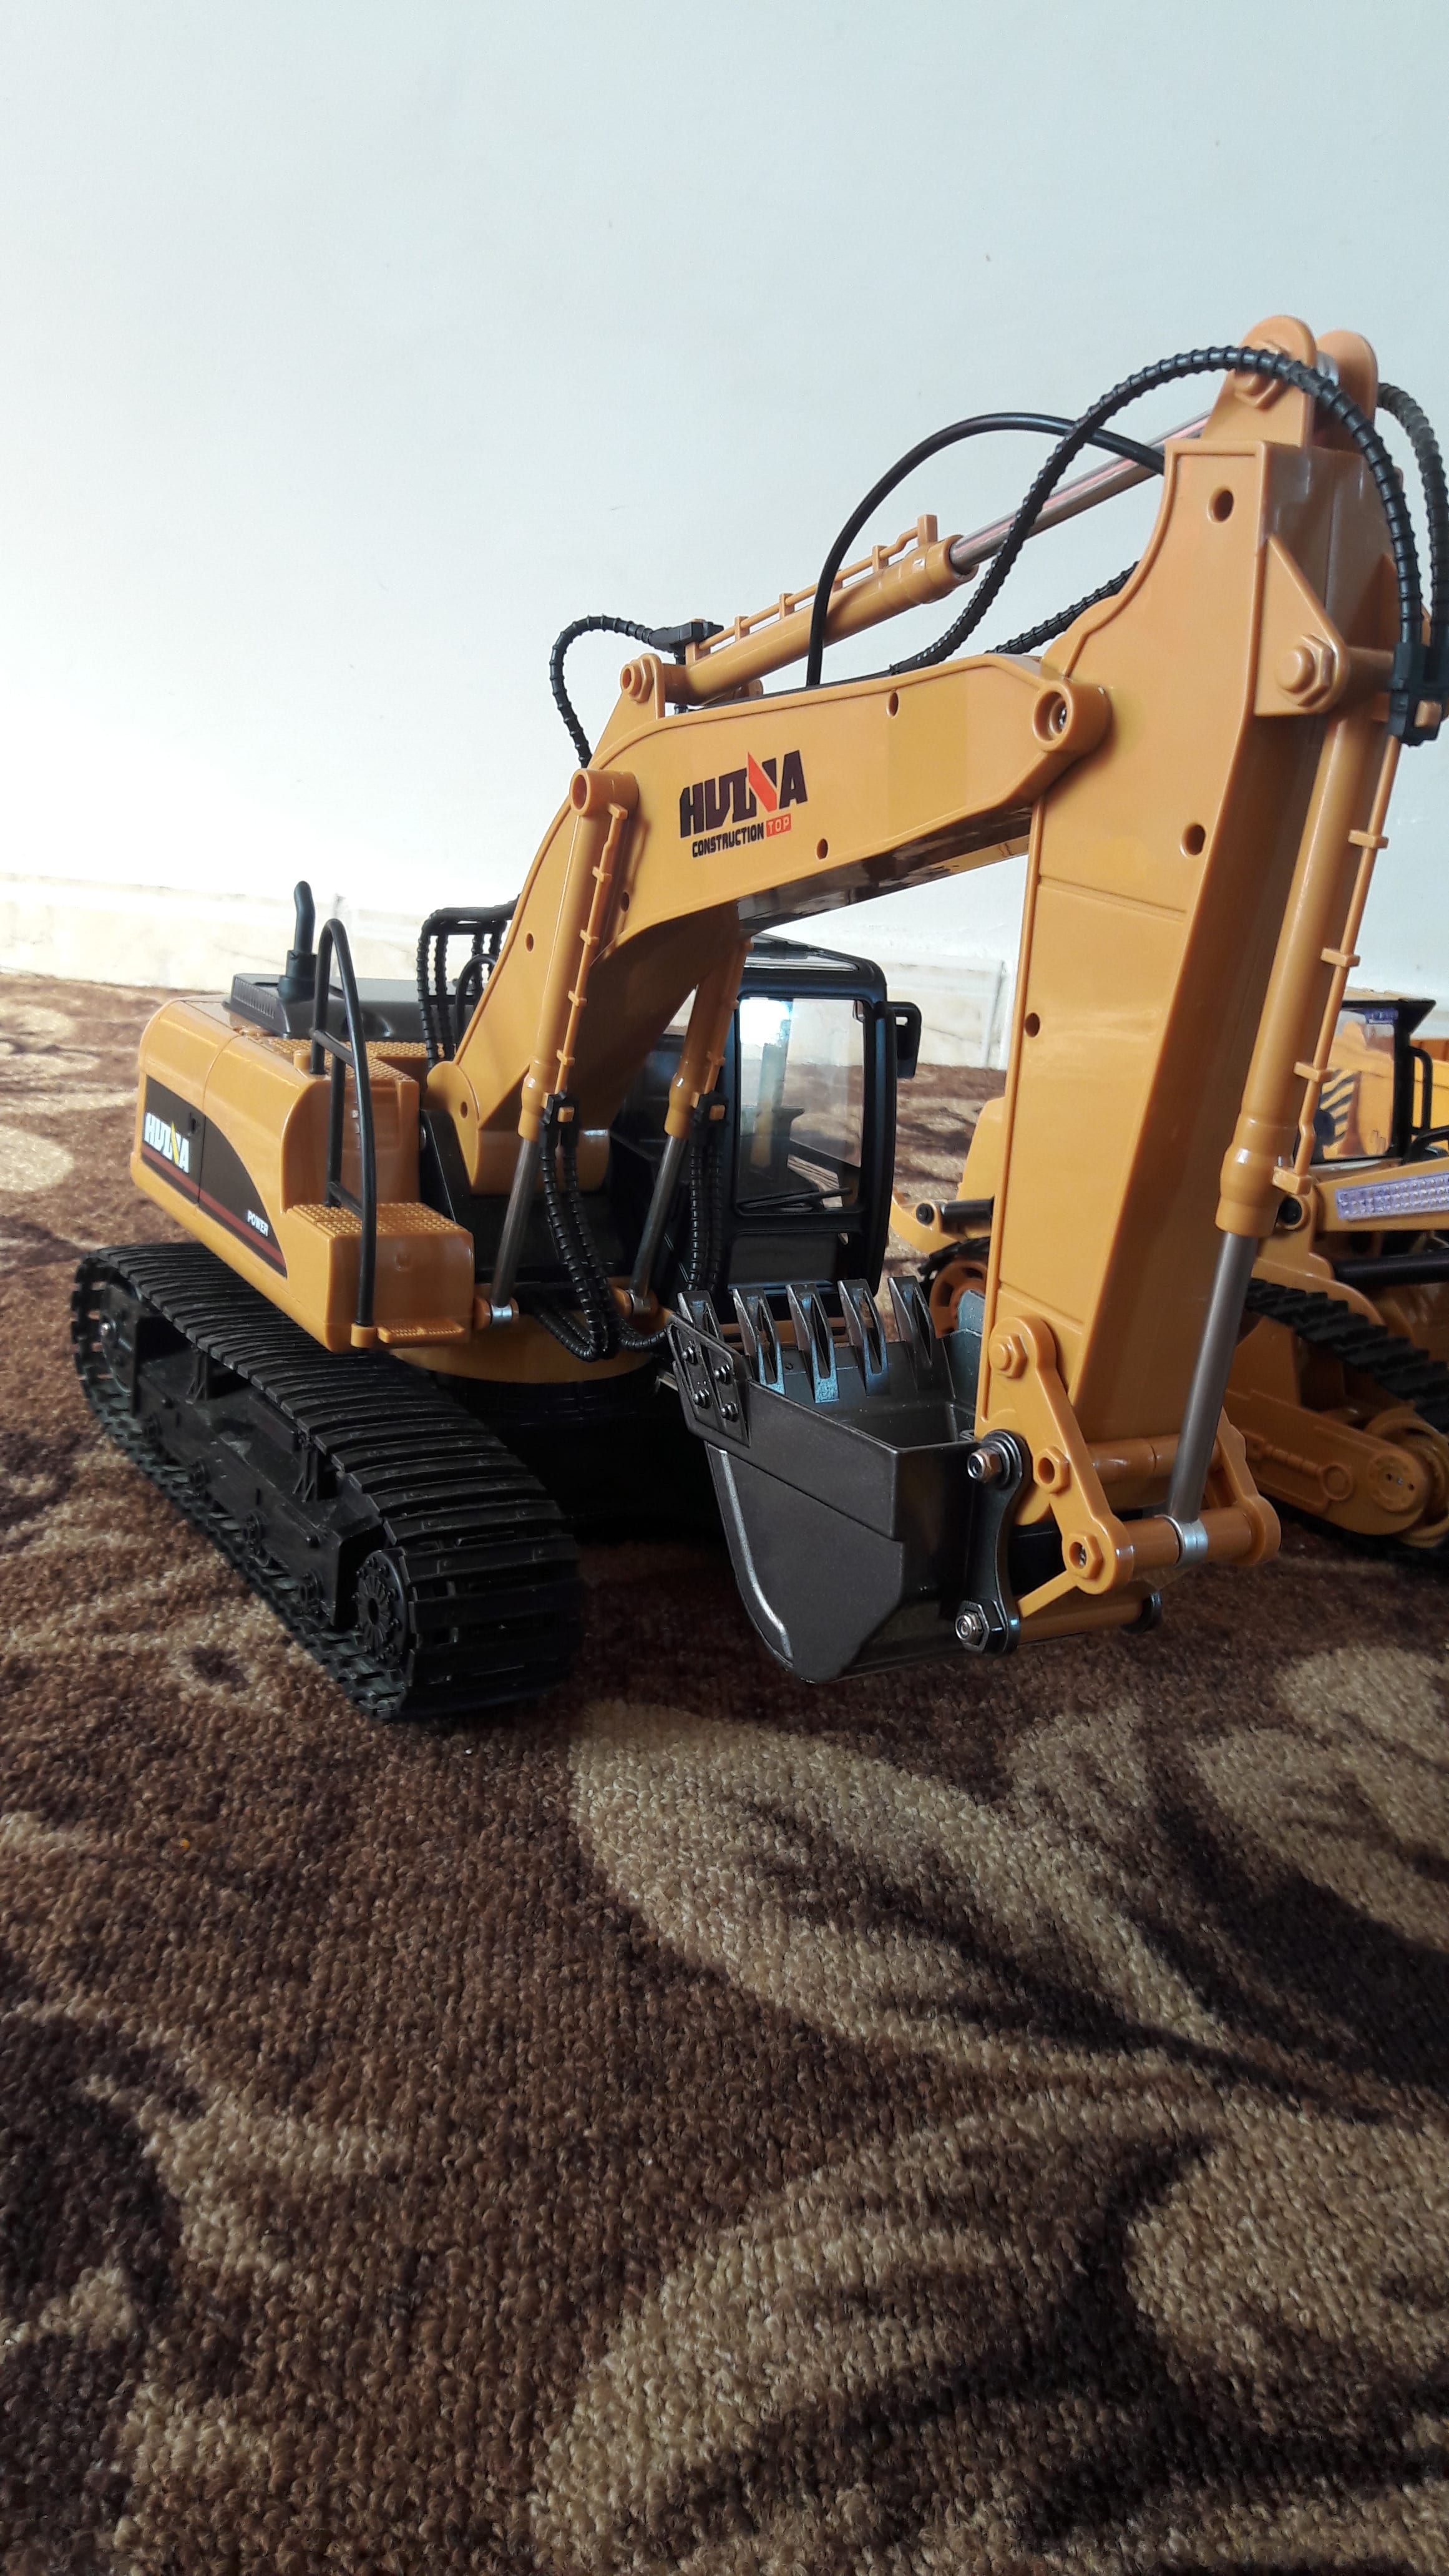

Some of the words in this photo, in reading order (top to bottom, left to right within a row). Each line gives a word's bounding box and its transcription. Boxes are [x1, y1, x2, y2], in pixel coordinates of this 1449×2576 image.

[692, 822, 764, 858] CONSTRUCTION
[768, 816, 790, 834] TOP
[247, 1209, 268, 1237] POWER
